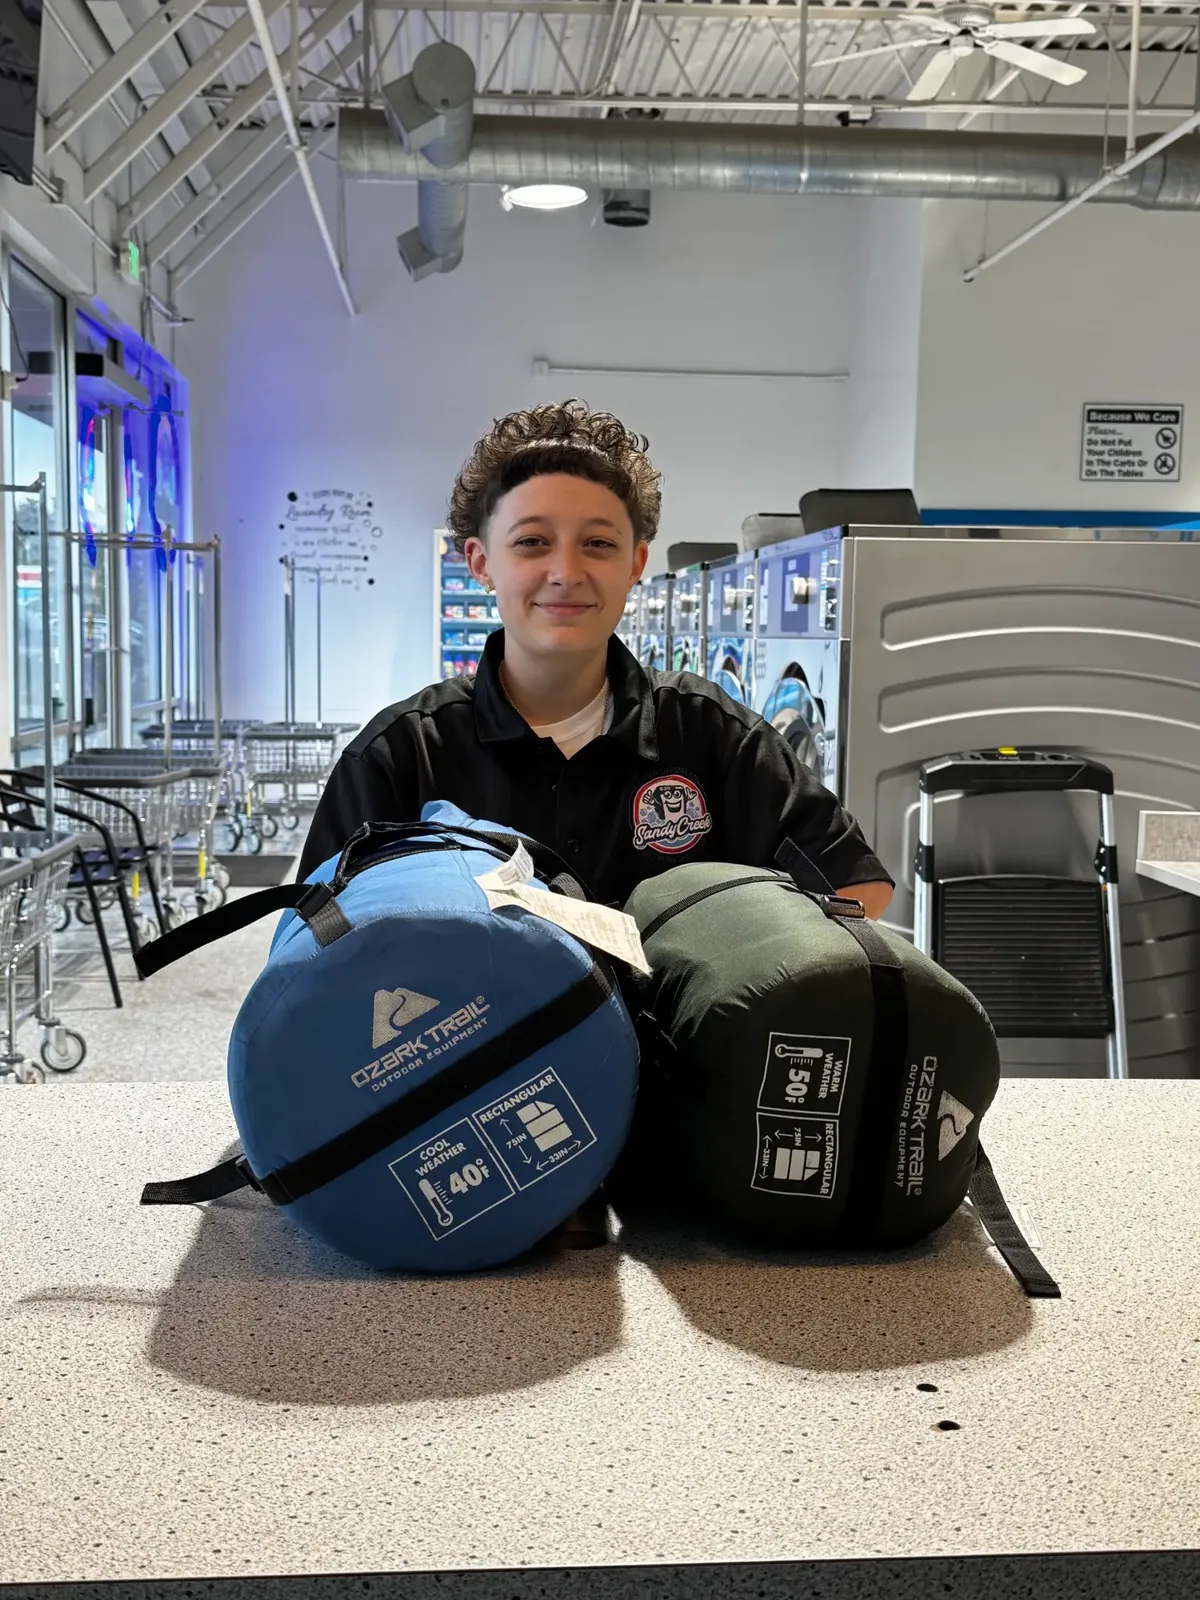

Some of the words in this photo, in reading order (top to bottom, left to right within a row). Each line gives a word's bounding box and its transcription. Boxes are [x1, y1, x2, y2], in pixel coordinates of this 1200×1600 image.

[1089, 411, 1132, 421] Because
[1134, 412, 1151, 421] We
[1152, 412, 1176, 422] Care
[1086, 438, 1099, 446] Do
[1100, 438, 1116, 447] Not
[1118, 438, 1132, 447] Put
[1086, 449, 1106, 457] Your
[1107, 449, 1142, 457] Children
[1085, 459, 1094, 467] In
[1096, 459, 1111, 467] The
[1113, 459, 1135, 467] Carts
[1137, 459, 1148, 467] Or
[1085, 469, 1098, 477] On
[1099, 469, 1115, 477] The
[1117, 469, 1144, 478] Tables
[635, 820, 677, 845] Sandy
[676, 815, 711, 836] Creek
[371, 1058, 424, 1092] OUTDOOR
[426, 1017, 488, 1060] EQUIPMENT
[818, 1052, 834, 1099] WEATHER
[829, 1060, 844, 1093] WARM
[479, 1073, 556, 1124] RECTANGULAR
[900, 1064, 918, 1118] OUTDOOR
[419, 1138, 451, 1161] COOL
[505, 1132, 528, 1150] 75IN
[548, 1148, 569, 1164] 33IN
[894, 1122, 907, 1188] EQUIPMENT
[415, 1142, 467, 1177] WEATHER
[819, 1123, 834, 1195] RECTANGULAR
